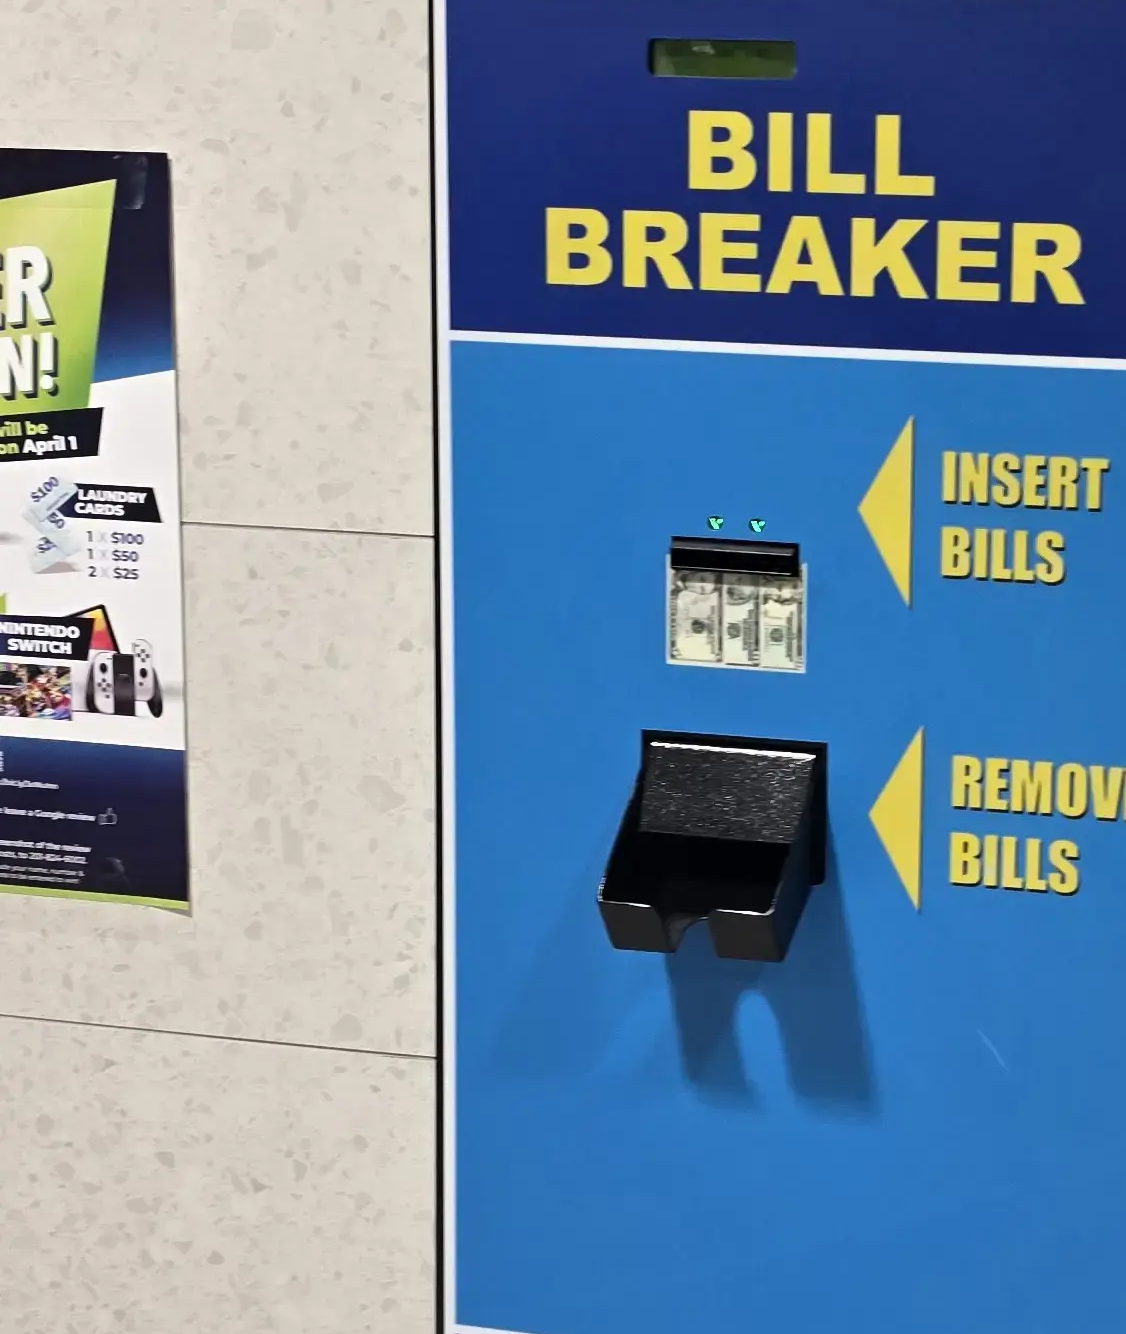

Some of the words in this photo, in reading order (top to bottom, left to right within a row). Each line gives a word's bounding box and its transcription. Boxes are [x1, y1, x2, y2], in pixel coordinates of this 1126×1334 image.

[687, 109, 936, 198] BILL
[545, 207, 1086, 305] BREAKER
[24, 420, 49, 436] be
[22, 435, 66, 455] April
[67, 435, 78, 450] 1
[941, 451, 1111, 514] INSERT
[77, 488, 148, 504] LAUNDRY
[74, 502, 126, 517] CARDS
[86, 530, 94, 543] 1
[110, 531, 145, 546] $100
[86, 548, 94, 560] 1
[111, 549, 140, 563] $50
[940, 526, 1067, 584] BILLS
[87, 565, 97, 578] 2
[112, 566, 140, 580] $25
[7, 638, 73, 655] SWITCH
[949, 832, 1082, 896] BILLS
